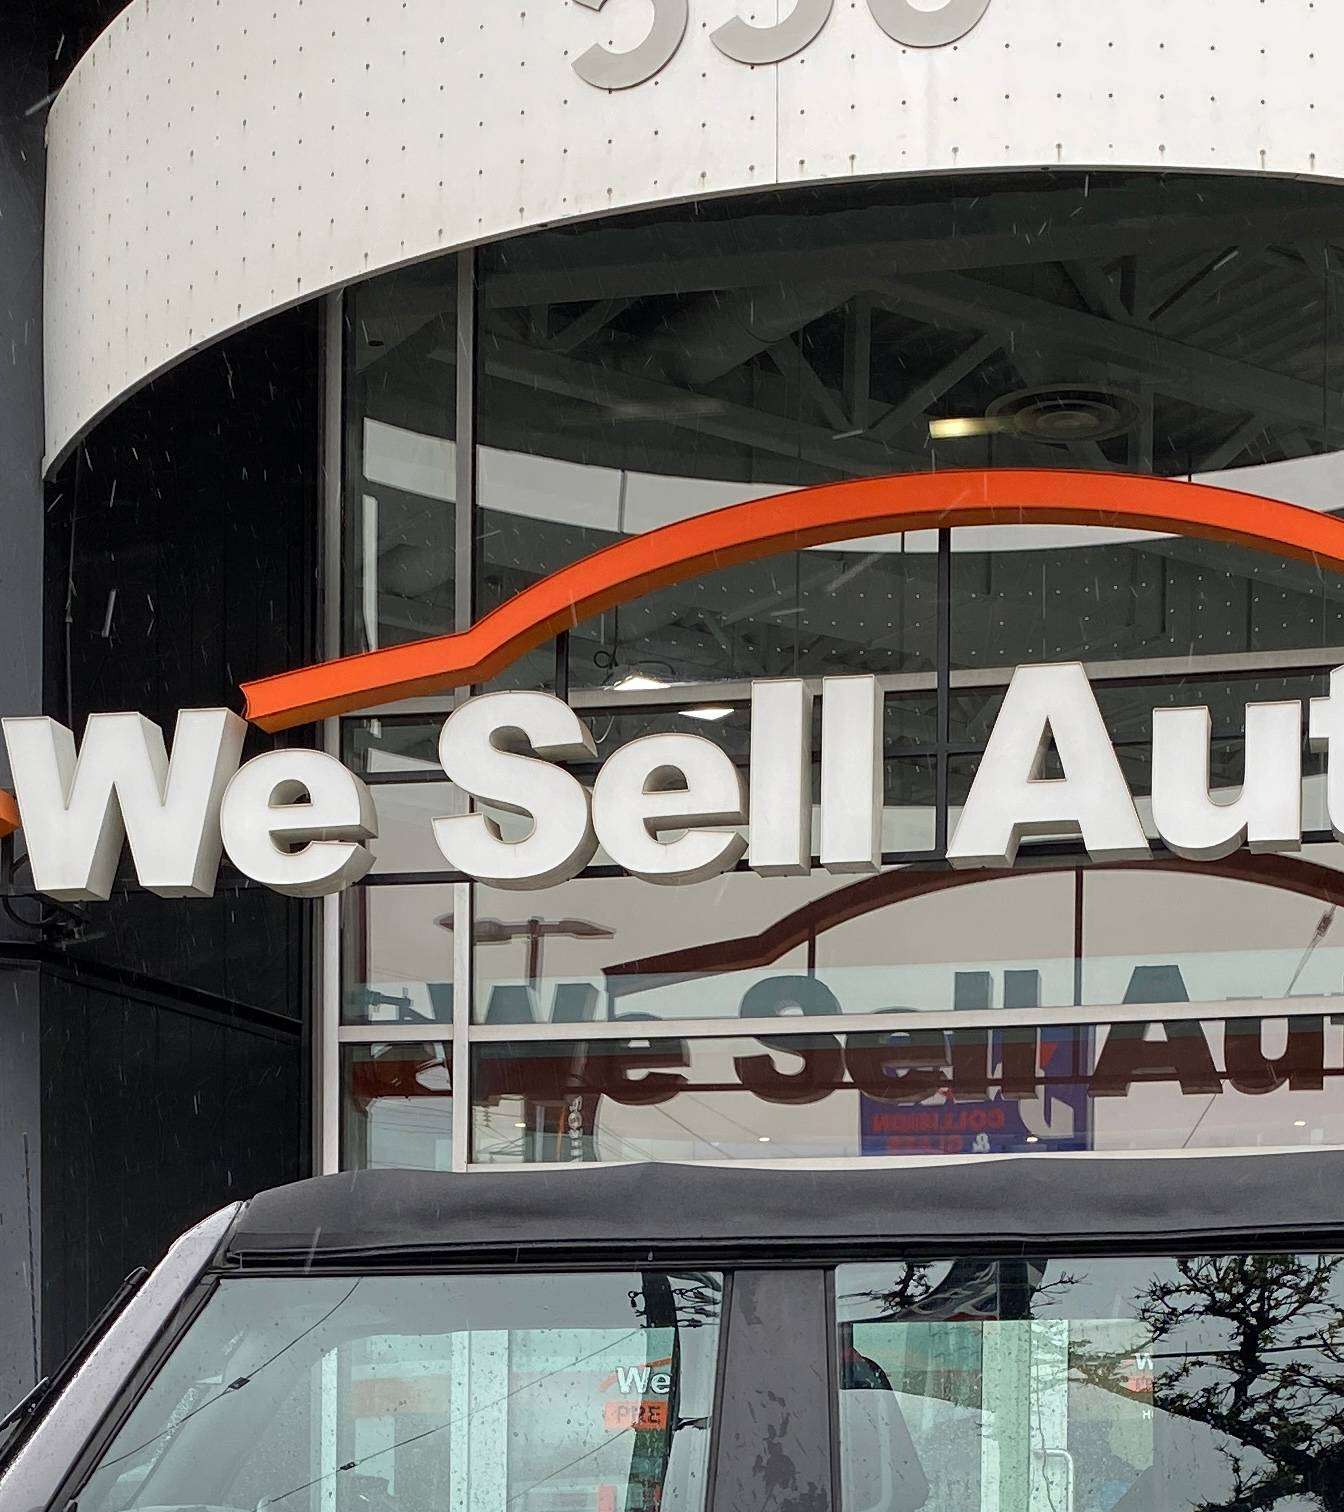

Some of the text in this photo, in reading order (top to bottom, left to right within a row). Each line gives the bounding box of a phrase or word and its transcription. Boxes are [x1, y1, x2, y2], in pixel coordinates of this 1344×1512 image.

[2, 707, 378, 902] We
[431, 673, 886, 891] Sell
[733, 969, 1041, 1104] Sell
[616, 1366, 672, 1394] We
